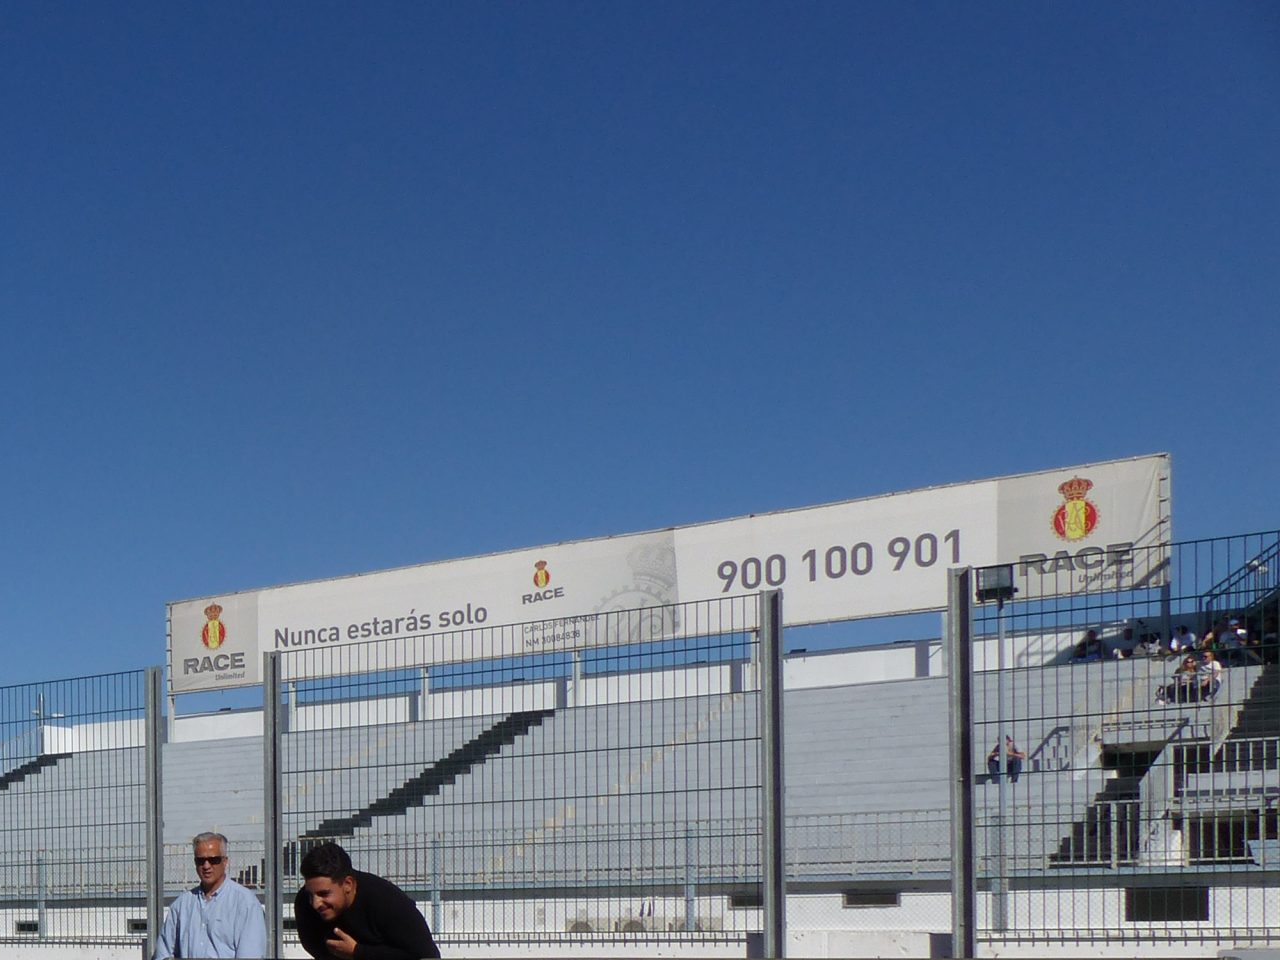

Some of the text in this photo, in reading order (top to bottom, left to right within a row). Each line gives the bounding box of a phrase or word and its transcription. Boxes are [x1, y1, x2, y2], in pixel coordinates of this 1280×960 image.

[716, 529, 960, 593] 900 100 901
[1019, 542, 1134, 577] RACE
[521, 587, 565, 605] RACE
[274, 603, 487, 649] Nunca estarás solo
[183, 652, 246, 675] RACE
[215, 671, 246, 681] Unlimited
